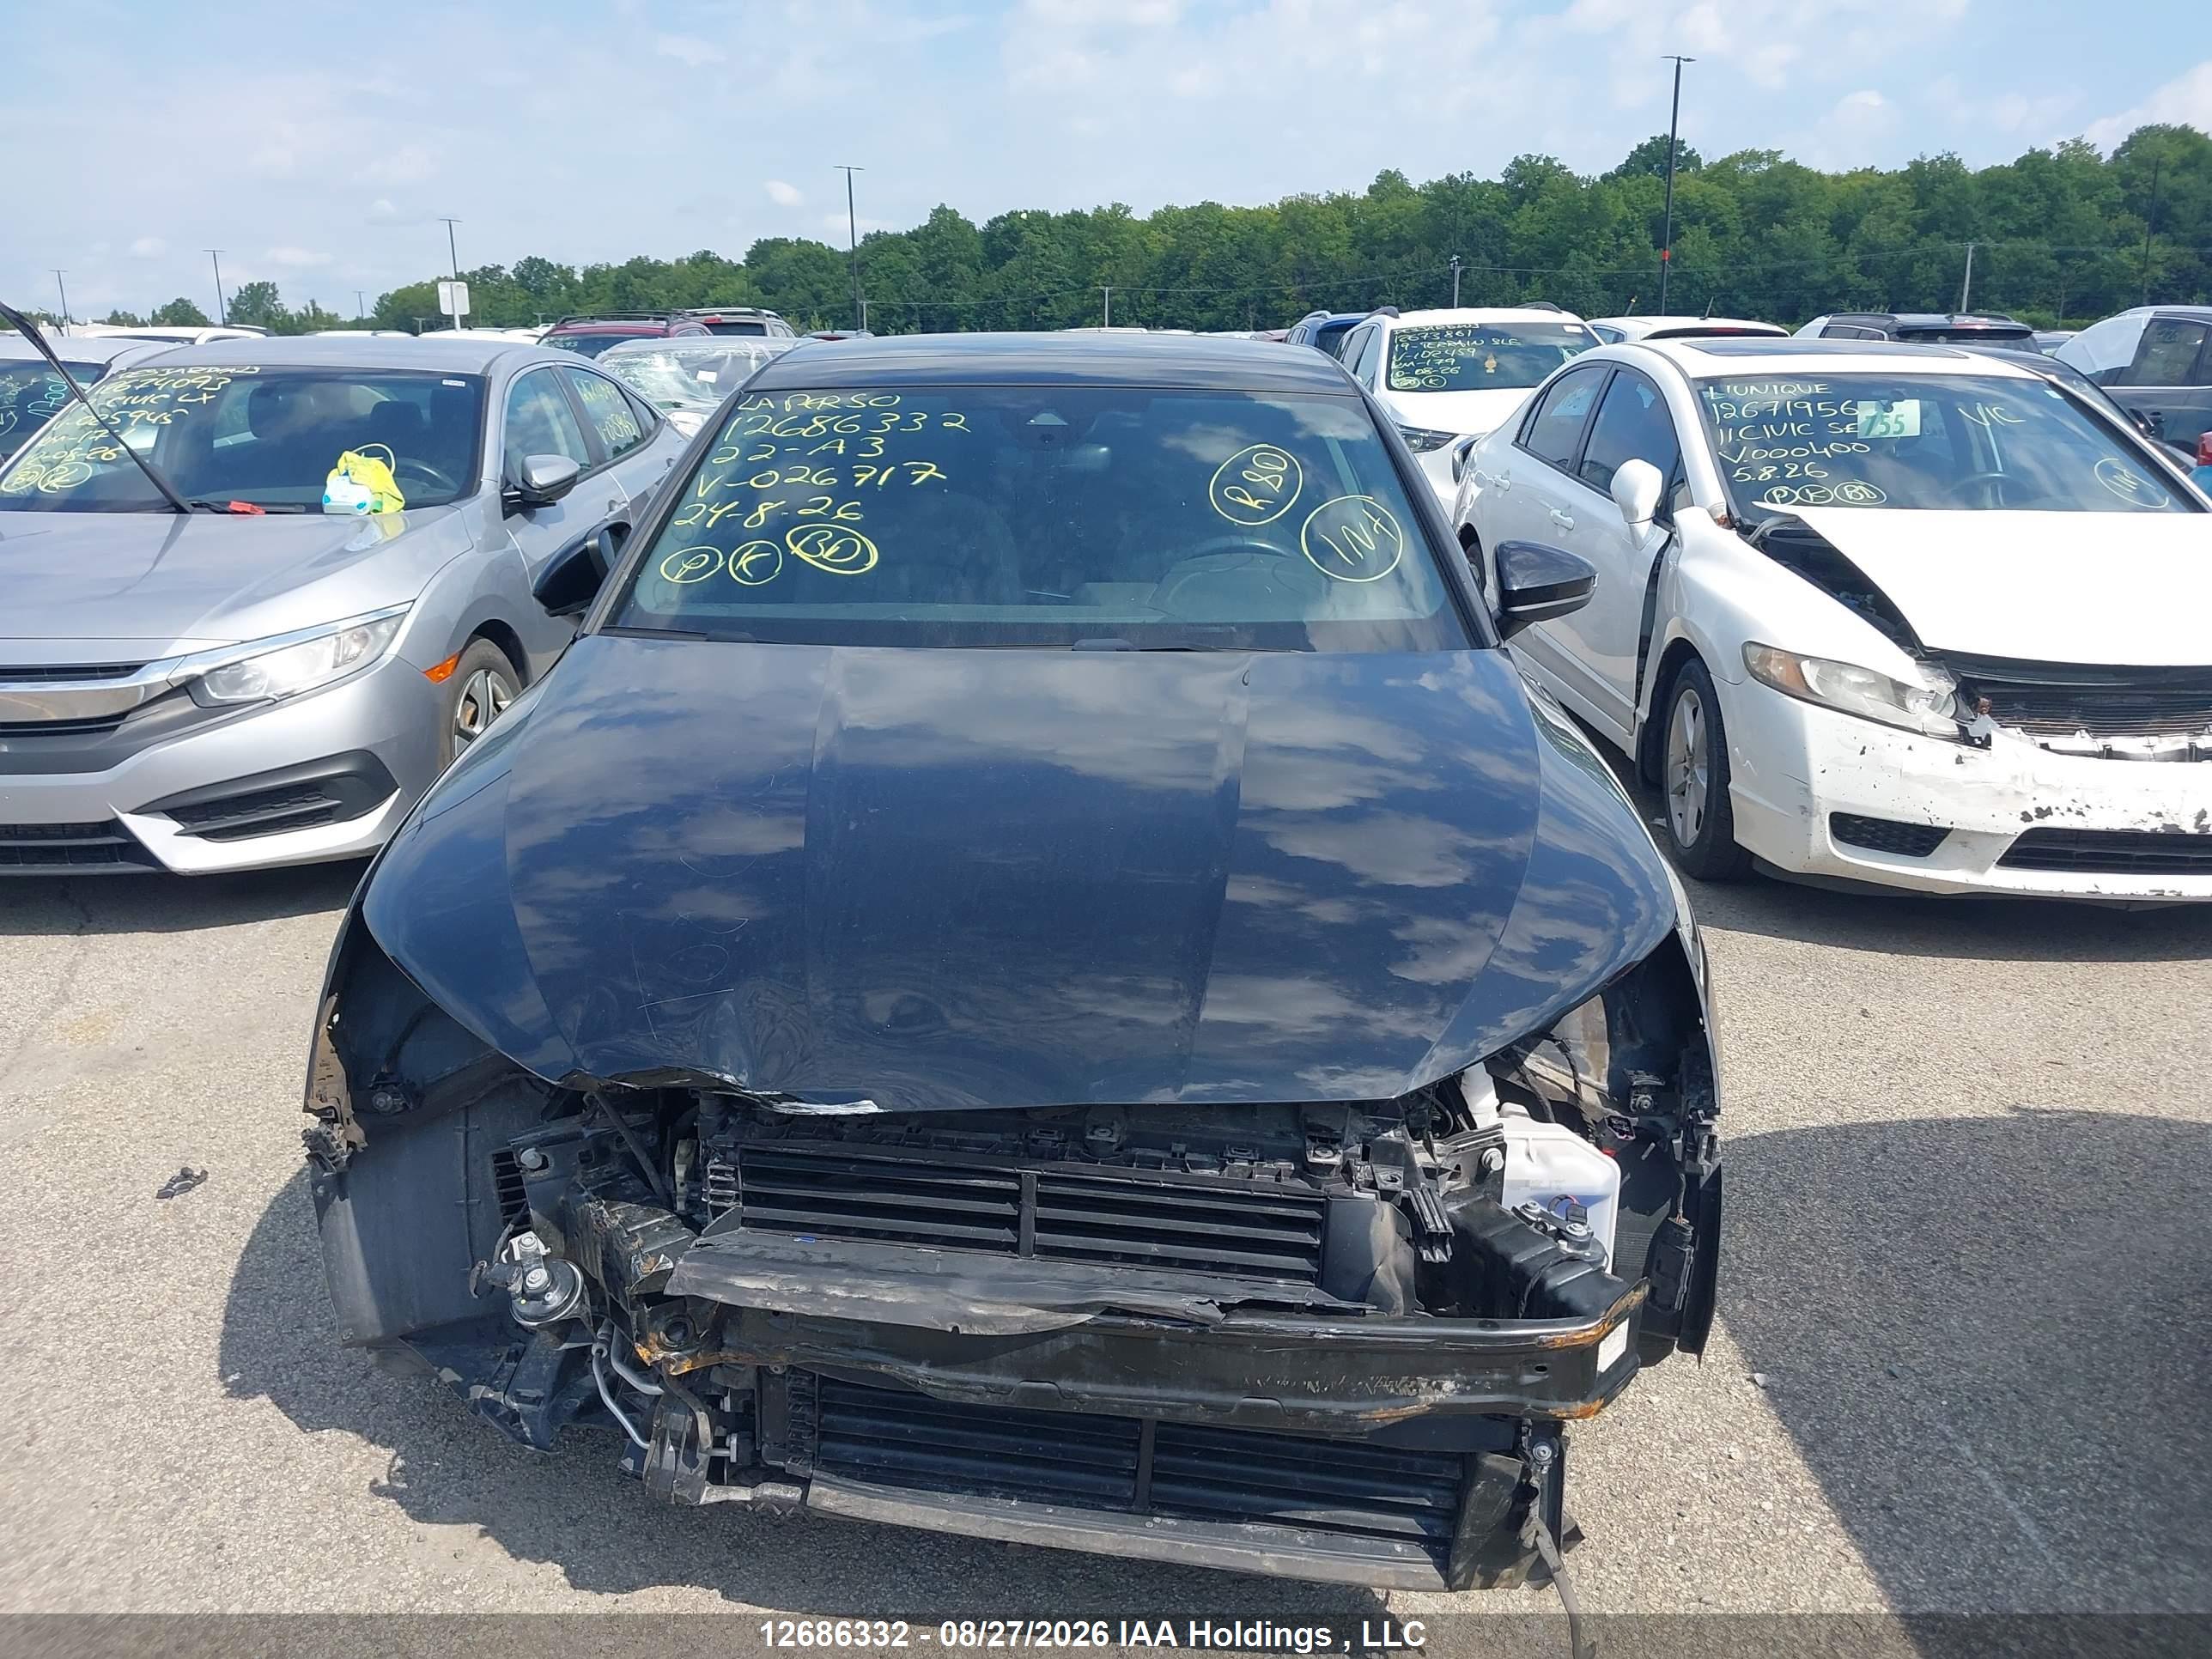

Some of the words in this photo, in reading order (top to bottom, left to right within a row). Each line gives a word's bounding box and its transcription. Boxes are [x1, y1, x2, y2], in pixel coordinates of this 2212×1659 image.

[177, 392, 216, 405] LX
[1709, 383, 1832, 400] L'UNIQUE
[738, 394, 775, 411] LA
[1711, 398, 1859, 425] 12671956
[724, 412, 971, 442] 12686332
[1863, 411, 1905, 437] 755
